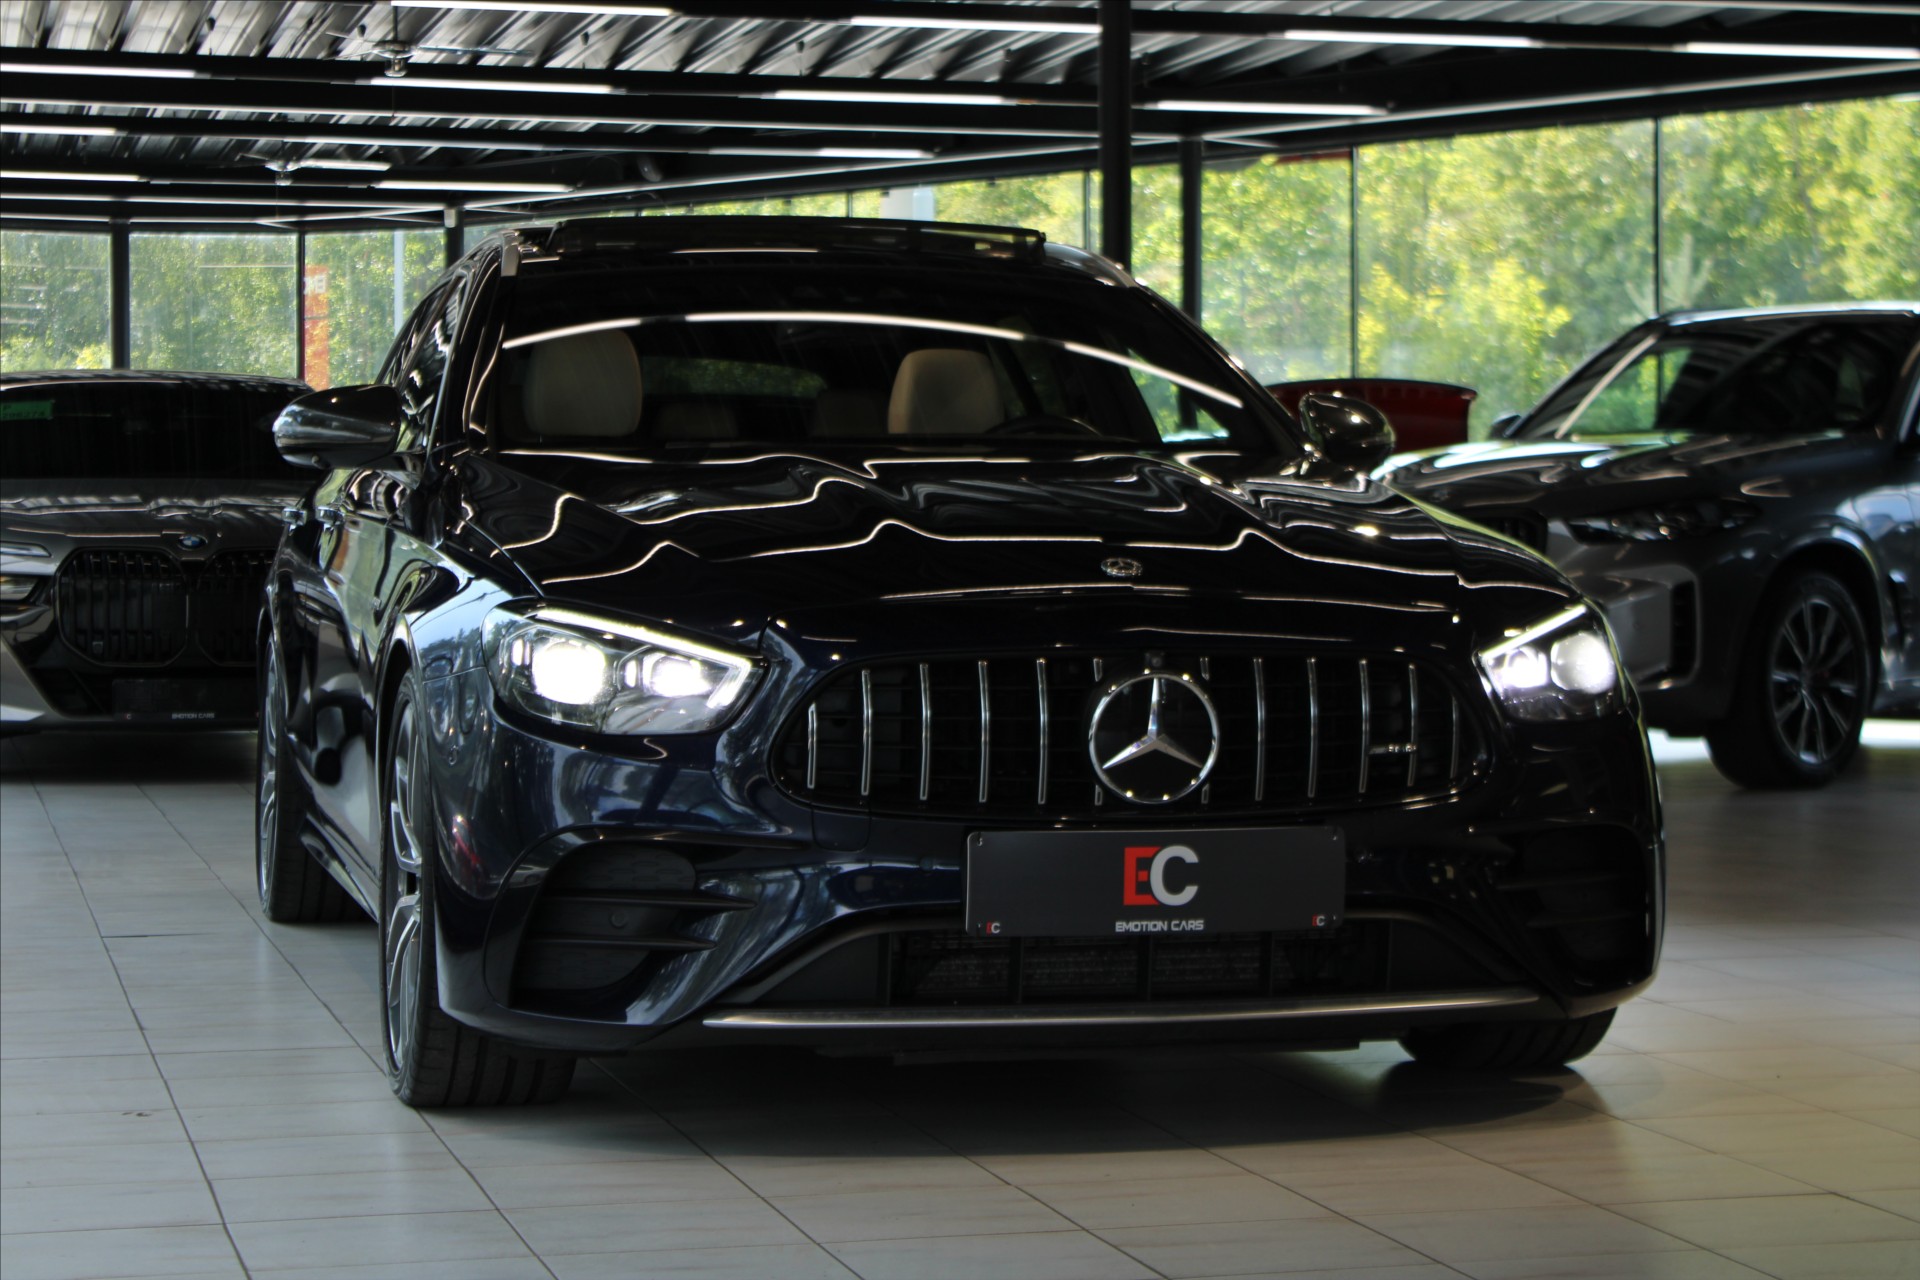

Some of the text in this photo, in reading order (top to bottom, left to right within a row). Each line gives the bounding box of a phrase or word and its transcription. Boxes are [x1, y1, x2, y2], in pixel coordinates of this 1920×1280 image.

[1123, 845, 1199, 907] EC
[1115, 919, 1204, 932] EMOTION CARS
